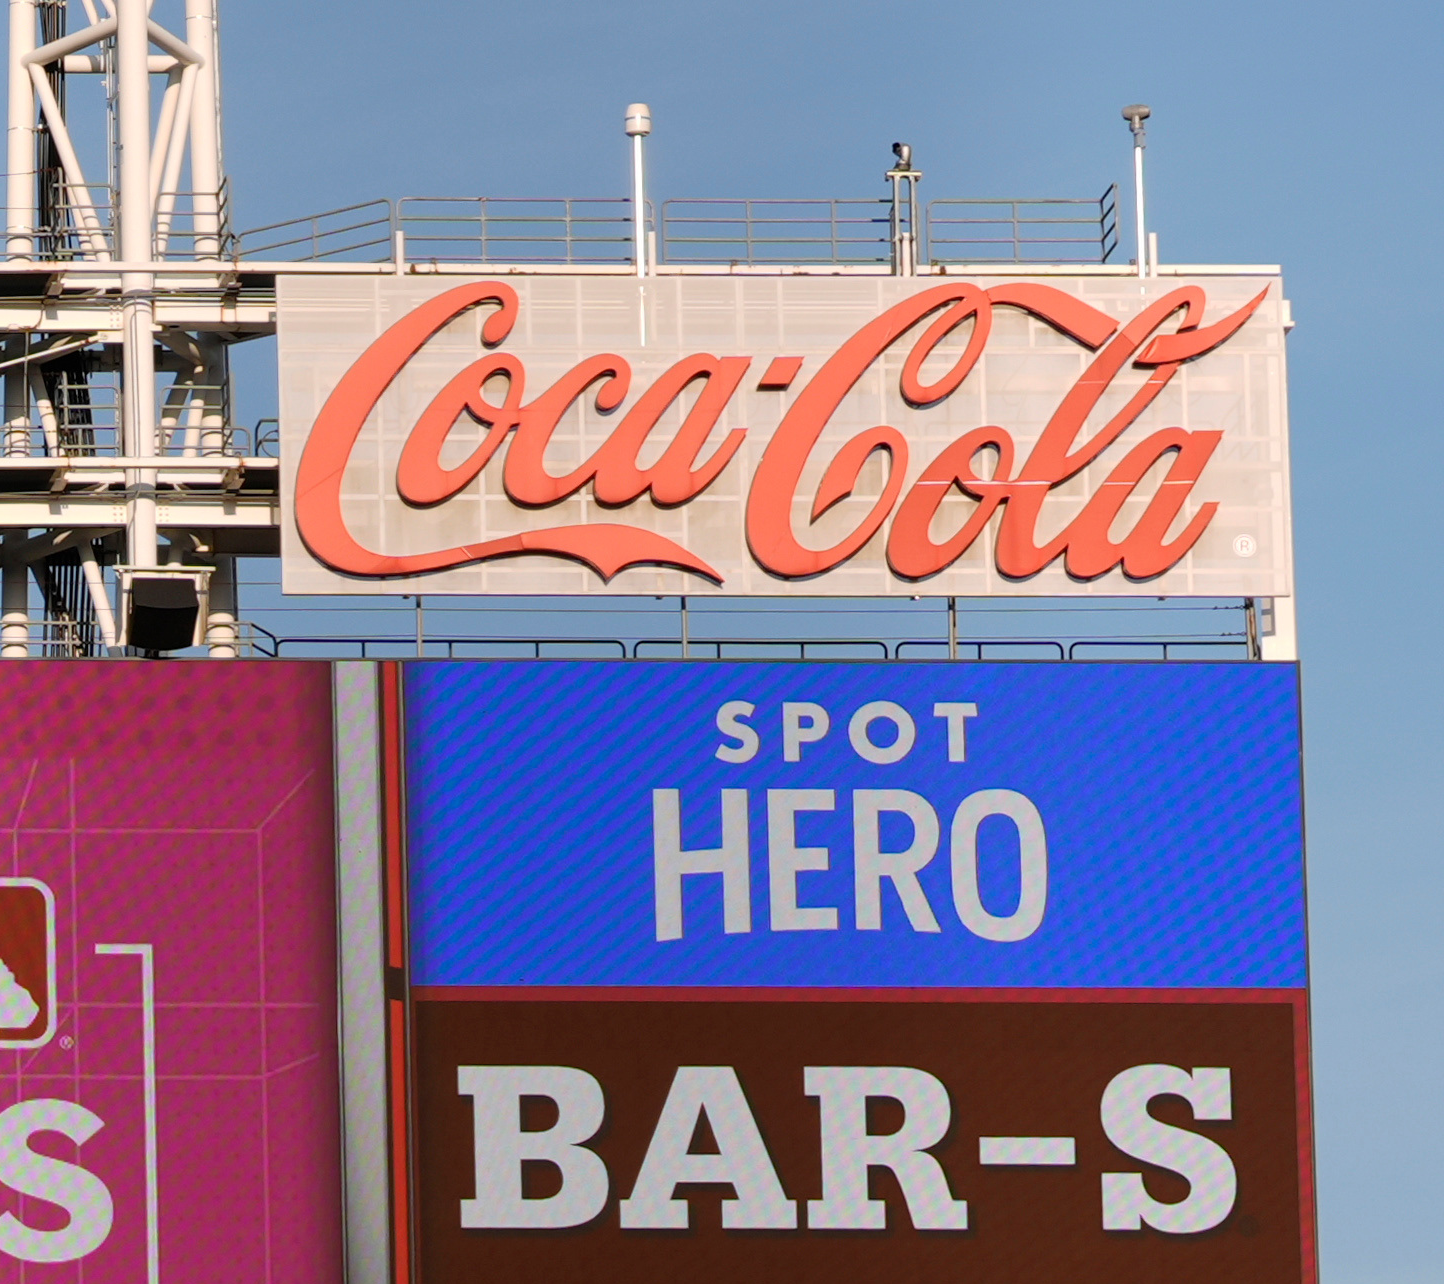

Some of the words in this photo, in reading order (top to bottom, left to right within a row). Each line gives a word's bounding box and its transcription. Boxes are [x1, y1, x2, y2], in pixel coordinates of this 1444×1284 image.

[294, 280, 1270, 583] Coca-Cola
[714, 701, 977, 764] SPOT
[653, 788, 1048, 942] HERO
[457, 1063, 1237, 1234] BAR-S
